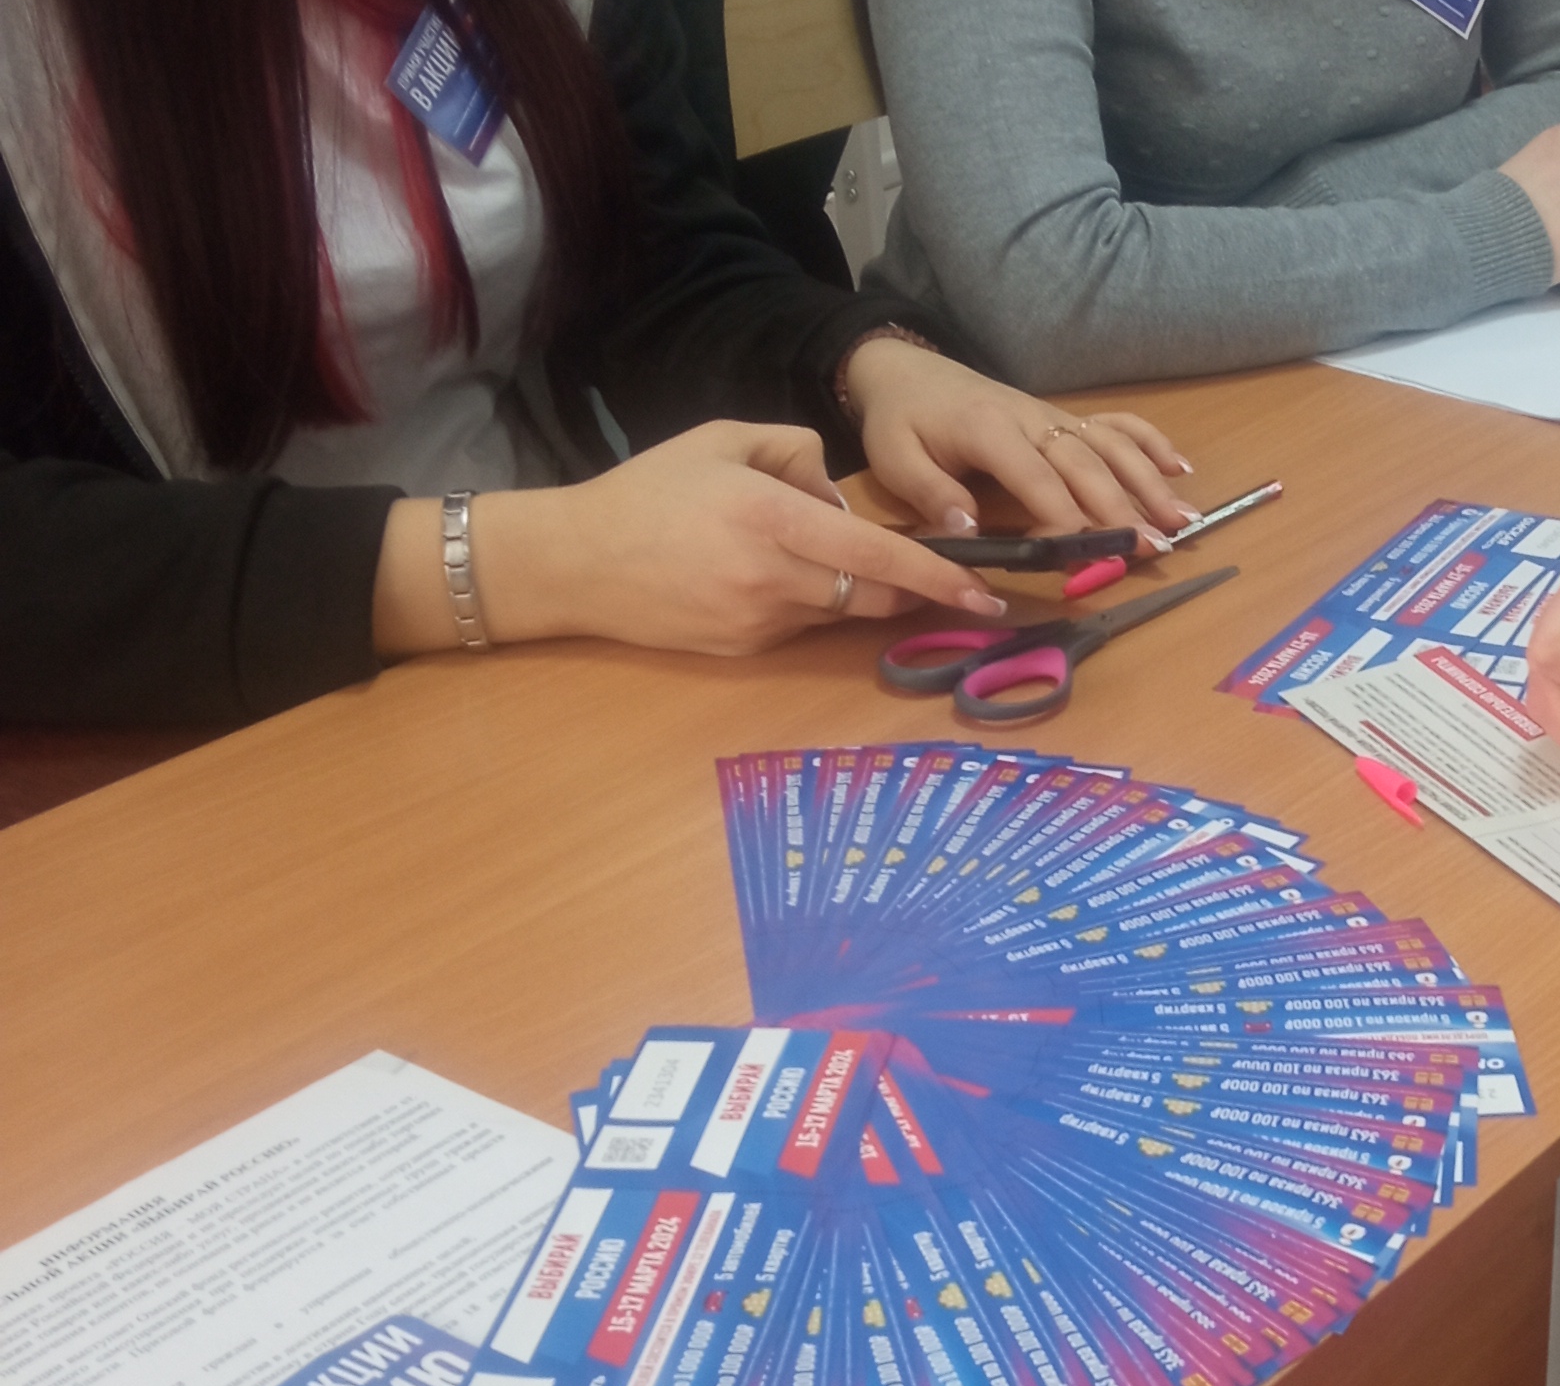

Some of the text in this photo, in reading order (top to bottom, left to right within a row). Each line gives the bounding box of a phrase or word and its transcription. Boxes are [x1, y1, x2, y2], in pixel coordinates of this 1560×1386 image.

[409, 87, 433, 111] В
[720, 1061, 766, 1122] ВЫБИРАЙ
[762, 1066, 806, 1120] РОССИЮ
[39, 1196, 164, 1267] ИНФОРМАЦИЯ
[67, 1231, 126, 1266] АКЦИИ
[629, 1245, 664, 1293] МАРТА
[647, 1216, 680, 1255] 2024
[527, 1233, 579, 1299] ВЫБИРАЙ
[575, 1238, 624, 1298] РОССИЮ
